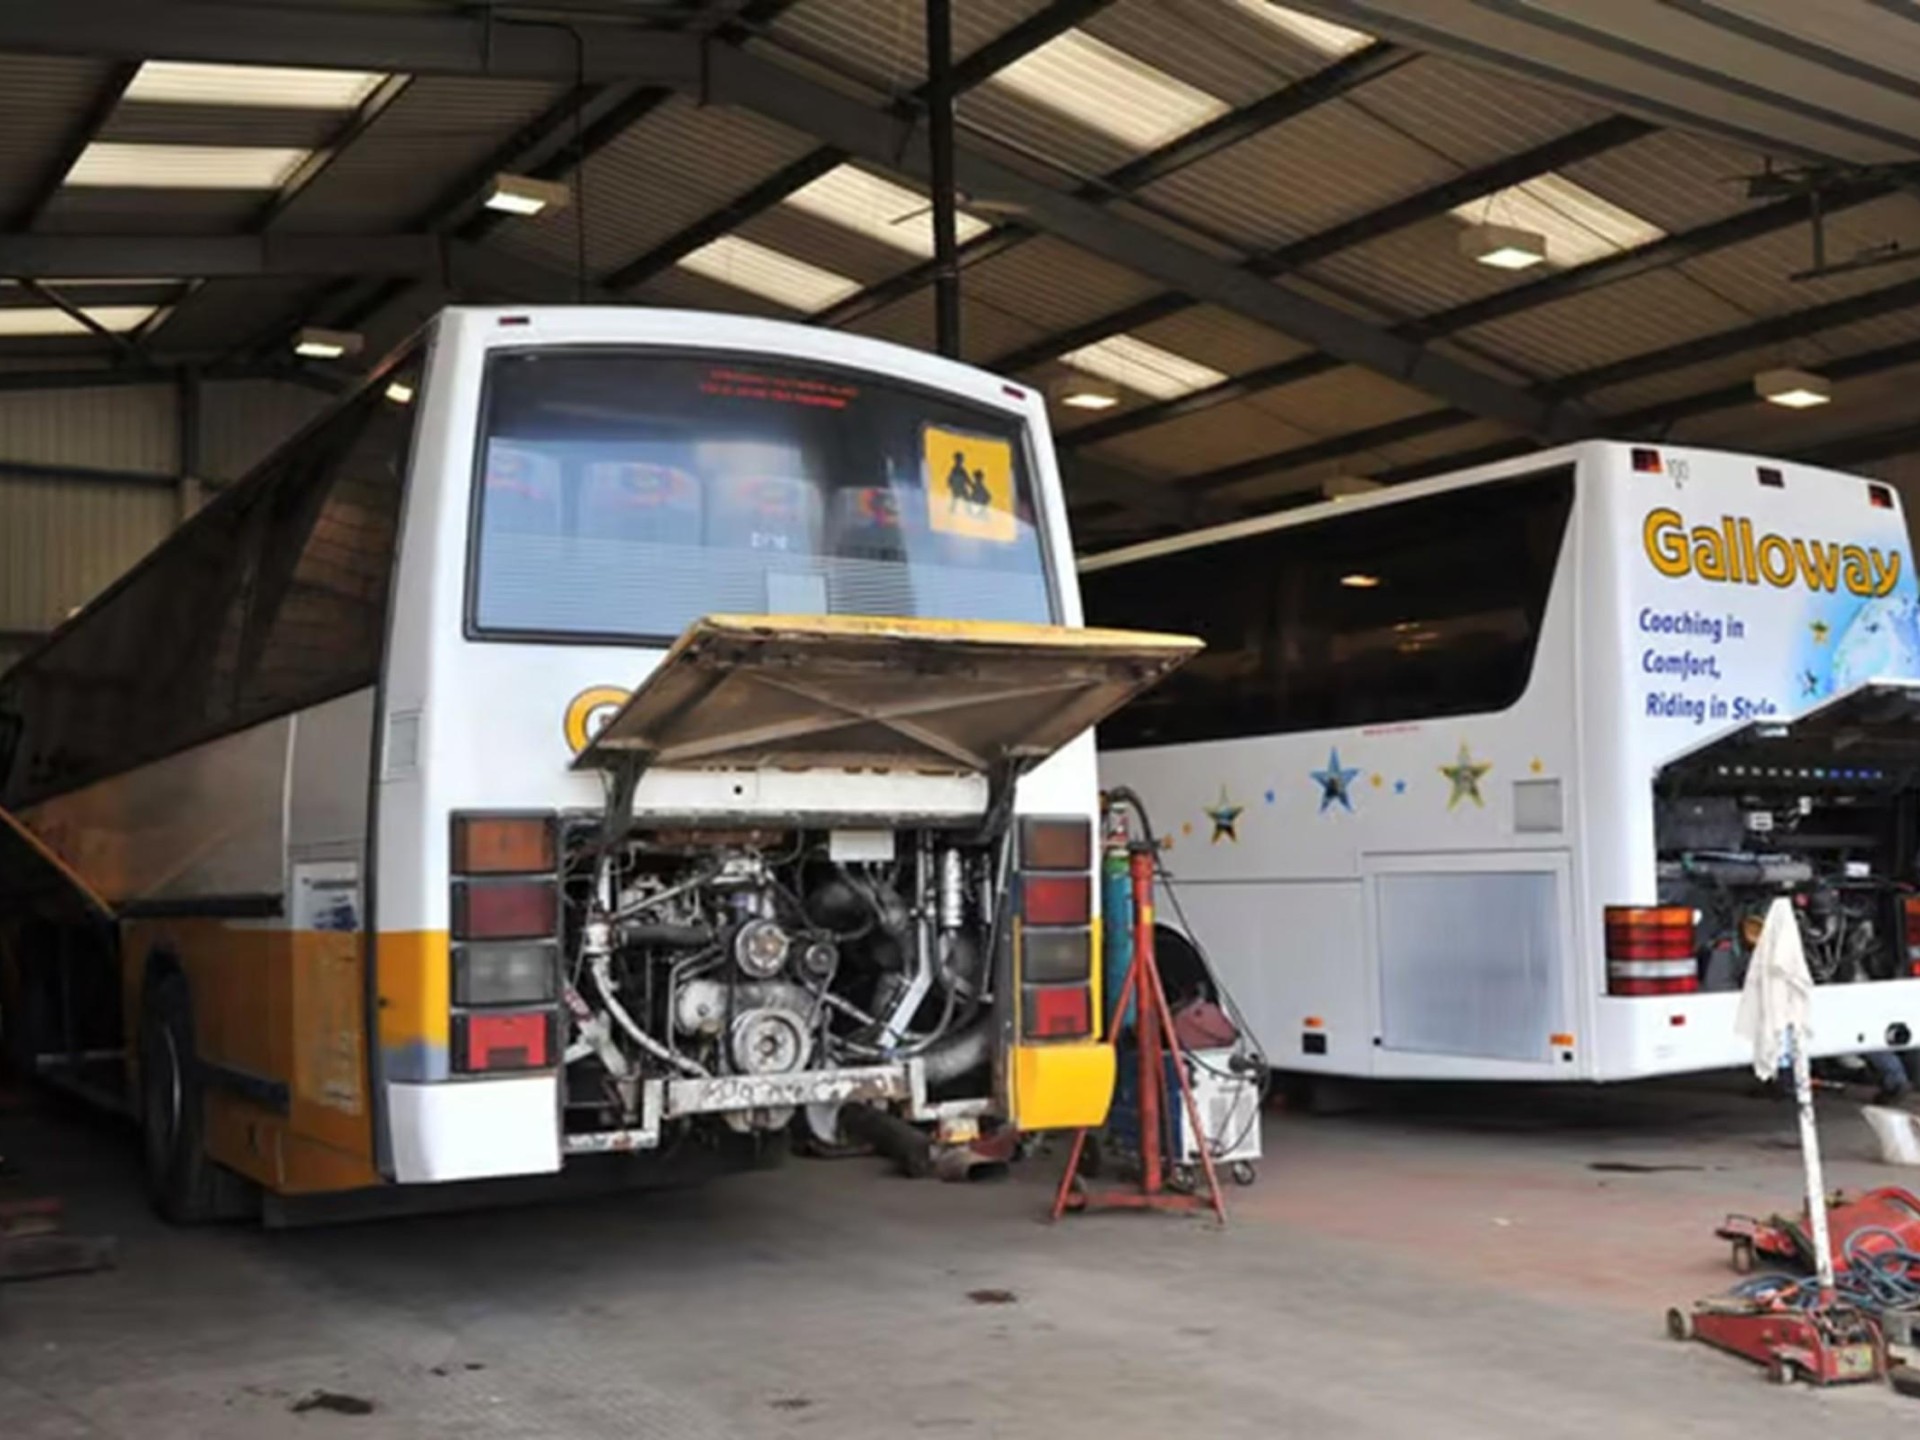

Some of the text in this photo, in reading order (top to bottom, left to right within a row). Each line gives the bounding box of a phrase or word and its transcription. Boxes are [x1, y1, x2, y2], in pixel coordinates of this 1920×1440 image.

[1643, 507, 1901, 598] Galloway
[1639, 607, 1744, 644] Coaching in
[1642, 648, 1722, 681] Comfort,
[1645, 692, 1705, 724] Riding
[1709, 693, 1728, 719] in
